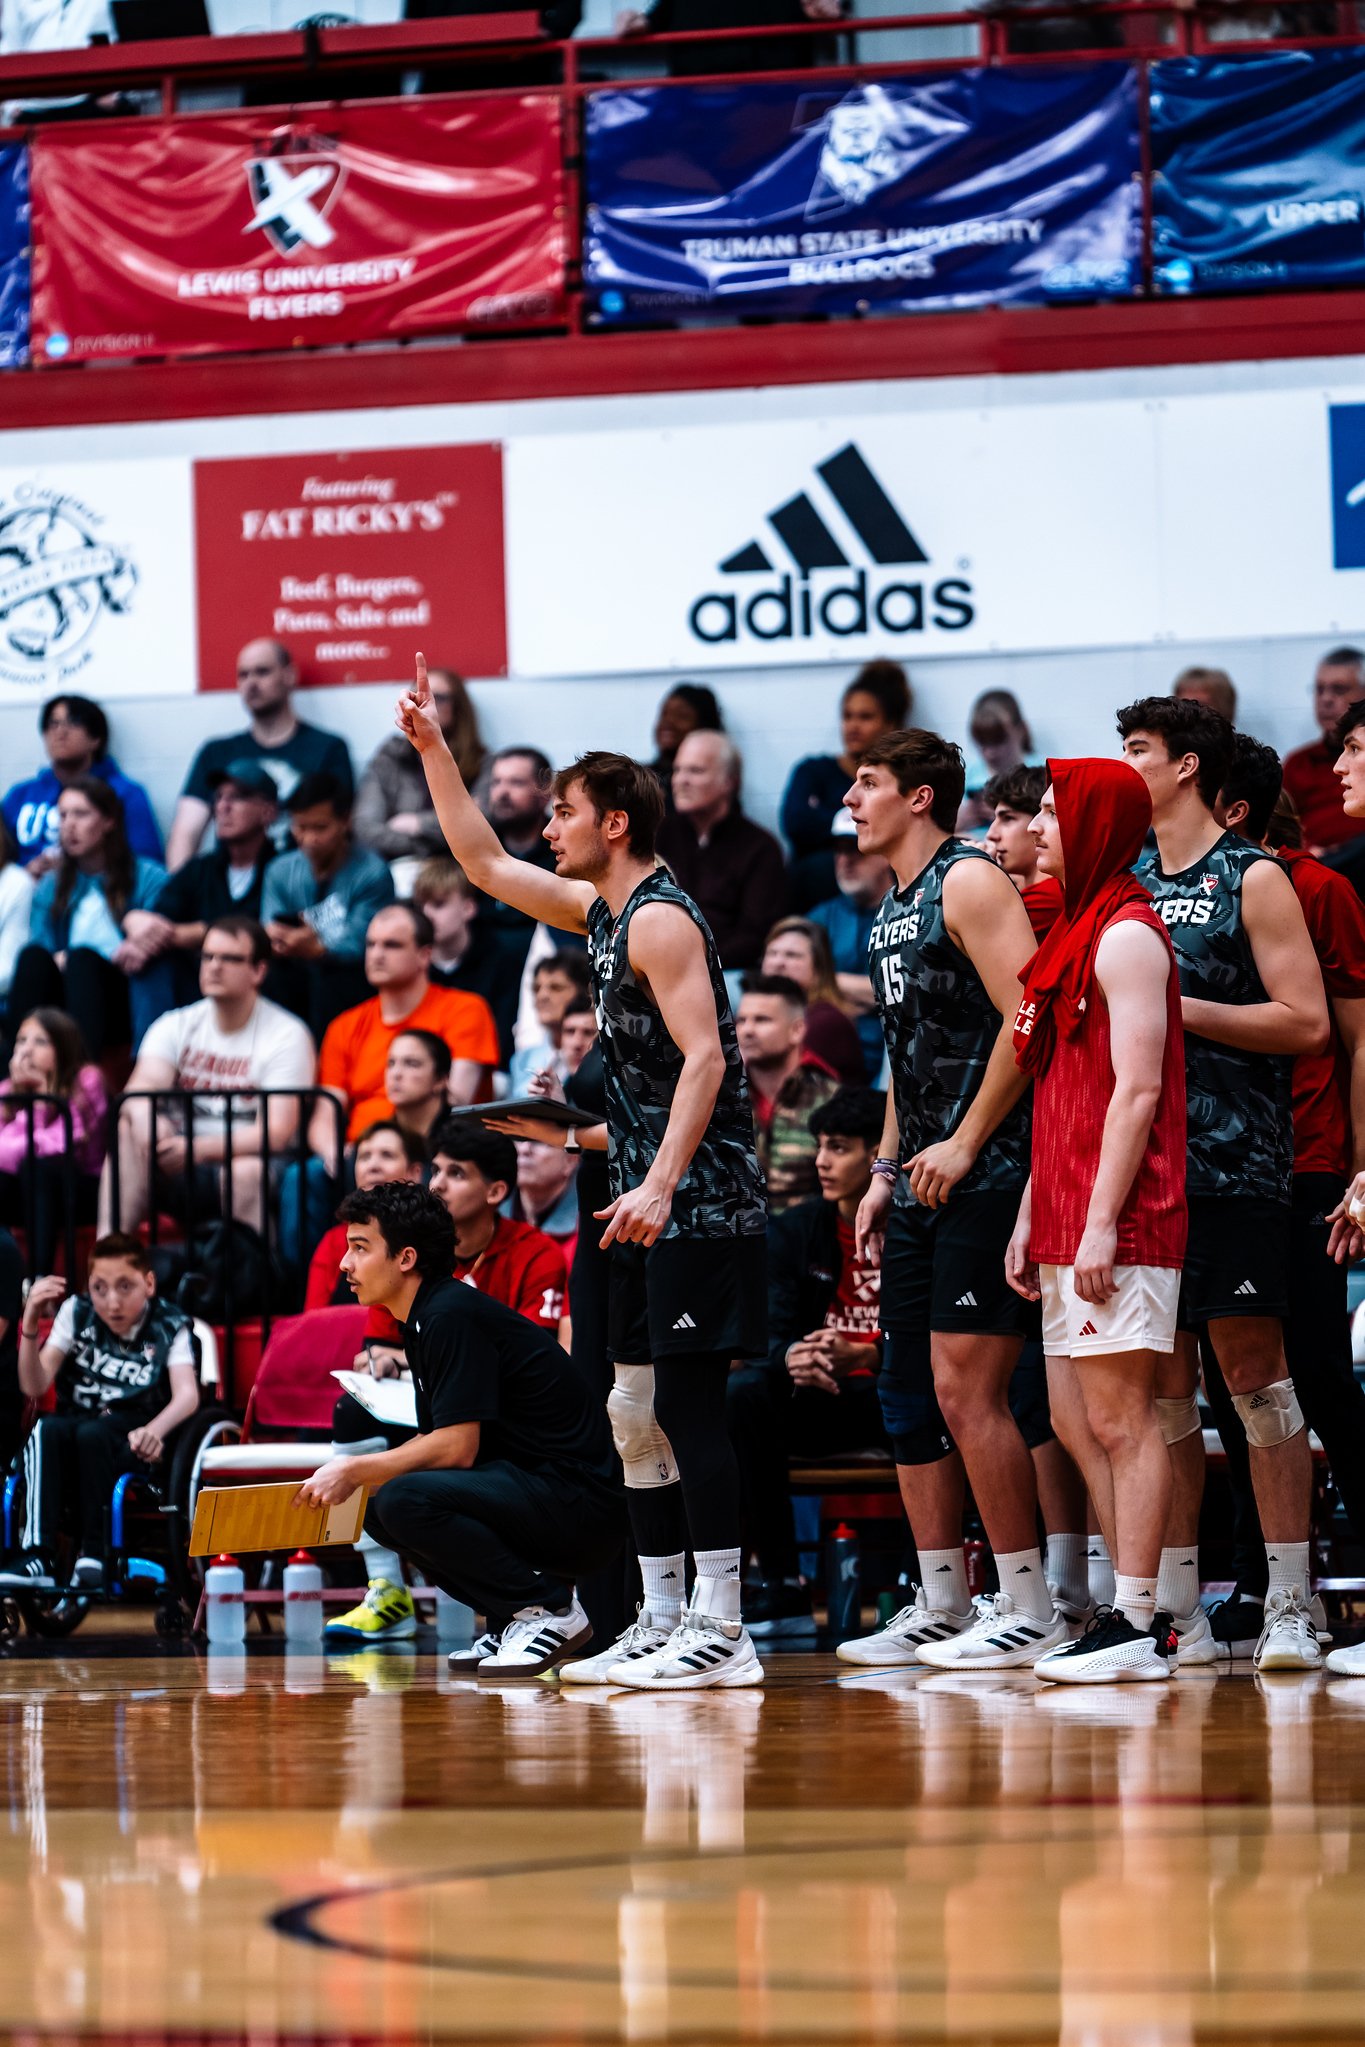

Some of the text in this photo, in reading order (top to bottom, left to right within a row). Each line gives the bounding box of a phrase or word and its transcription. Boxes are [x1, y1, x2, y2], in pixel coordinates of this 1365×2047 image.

[1266, 200, 1360, 229] UPPER
[681, 219, 1044, 262] TRUMAN STATE UNIVERSITY
[177, 257, 417, 298] LEWIS UNIVERSITY
[788, 254, 935, 286] BULLDOGS
[249, 291, 346, 321] FLYERS
[301, 475, 396, 502] Featuring
[241, 507, 308, 541] FAT
[335, 603, 386, 630] Subs
[387, 599, 431, 627] and
[688, 567, 975, 643] adidas
[868, 914, 920, 952] FLYERS
[881, 953, 904, 1006] 15
